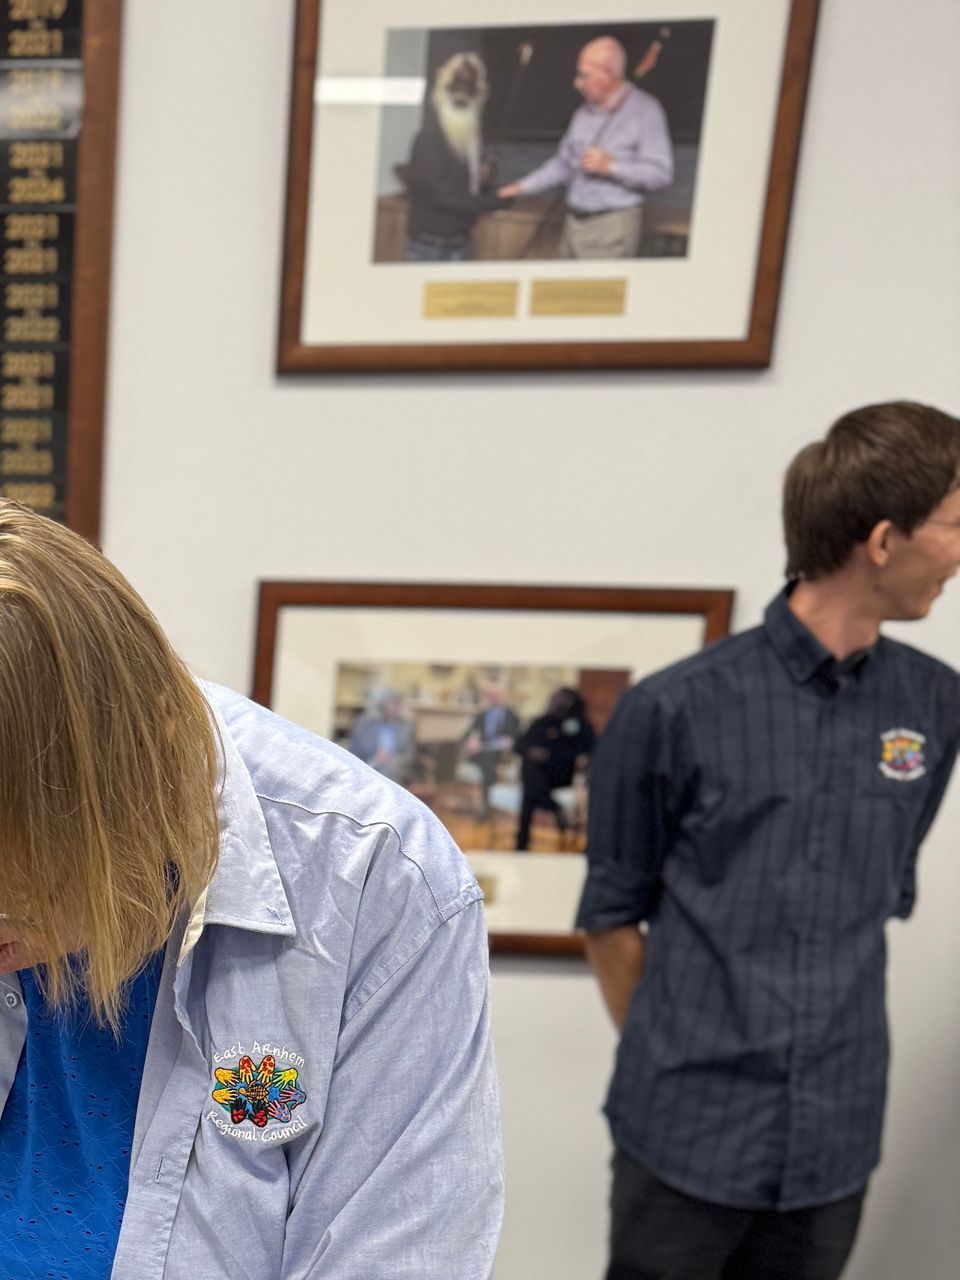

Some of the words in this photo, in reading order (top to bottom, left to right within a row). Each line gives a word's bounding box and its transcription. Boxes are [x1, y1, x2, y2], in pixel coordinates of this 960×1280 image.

[213, 1042, 245, 1063] East
[206, 1110, 258, 1141] Regional
[261, 1115, 308, 1142] Council
